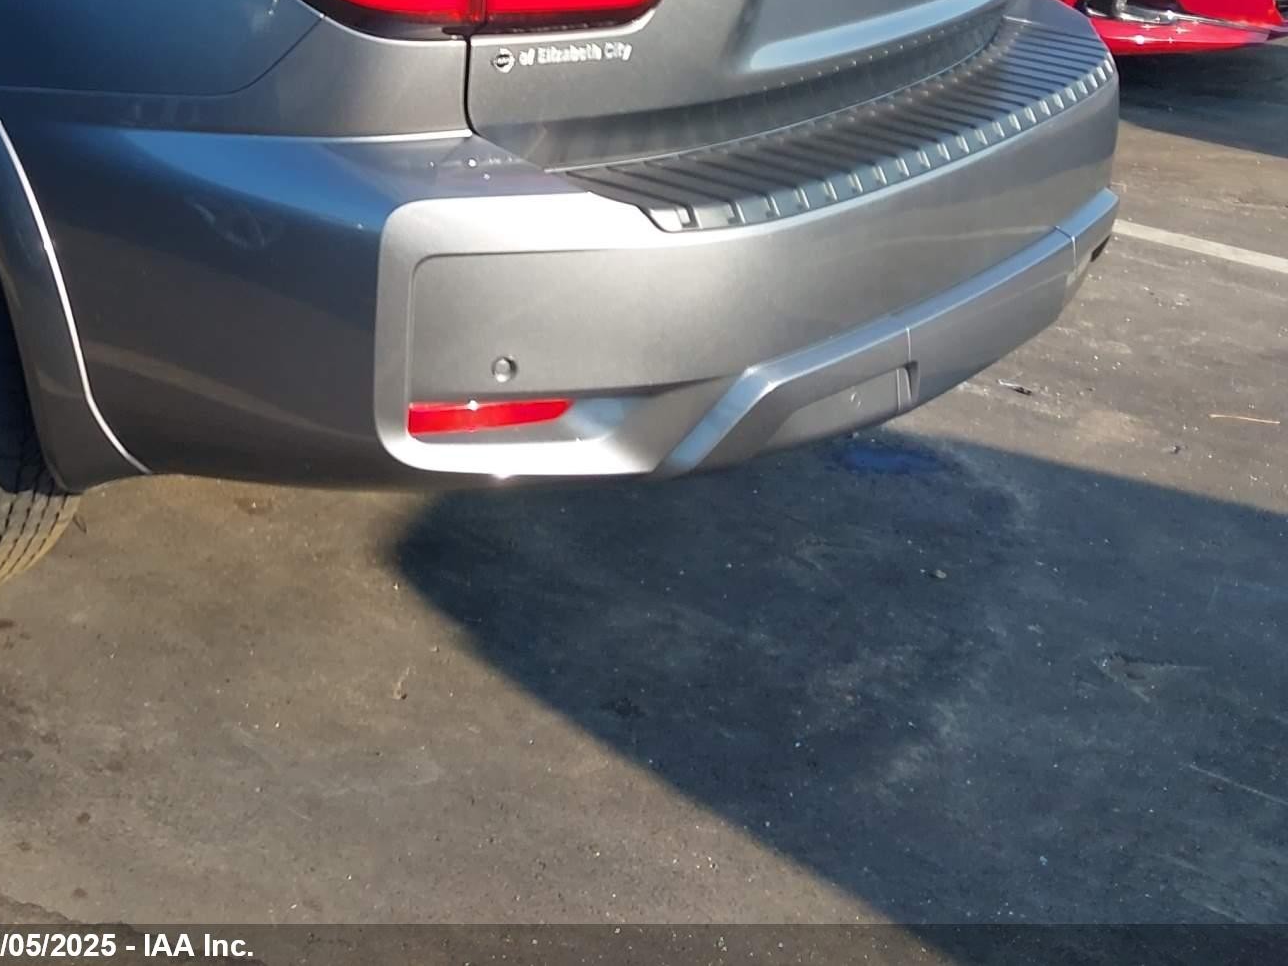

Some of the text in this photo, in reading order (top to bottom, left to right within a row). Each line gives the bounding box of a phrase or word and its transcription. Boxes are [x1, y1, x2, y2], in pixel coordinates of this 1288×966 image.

[519, 48, 535, 66] of
[537, 43, 602, 64] Elizabeth
[605, 41, 632, 61] City
